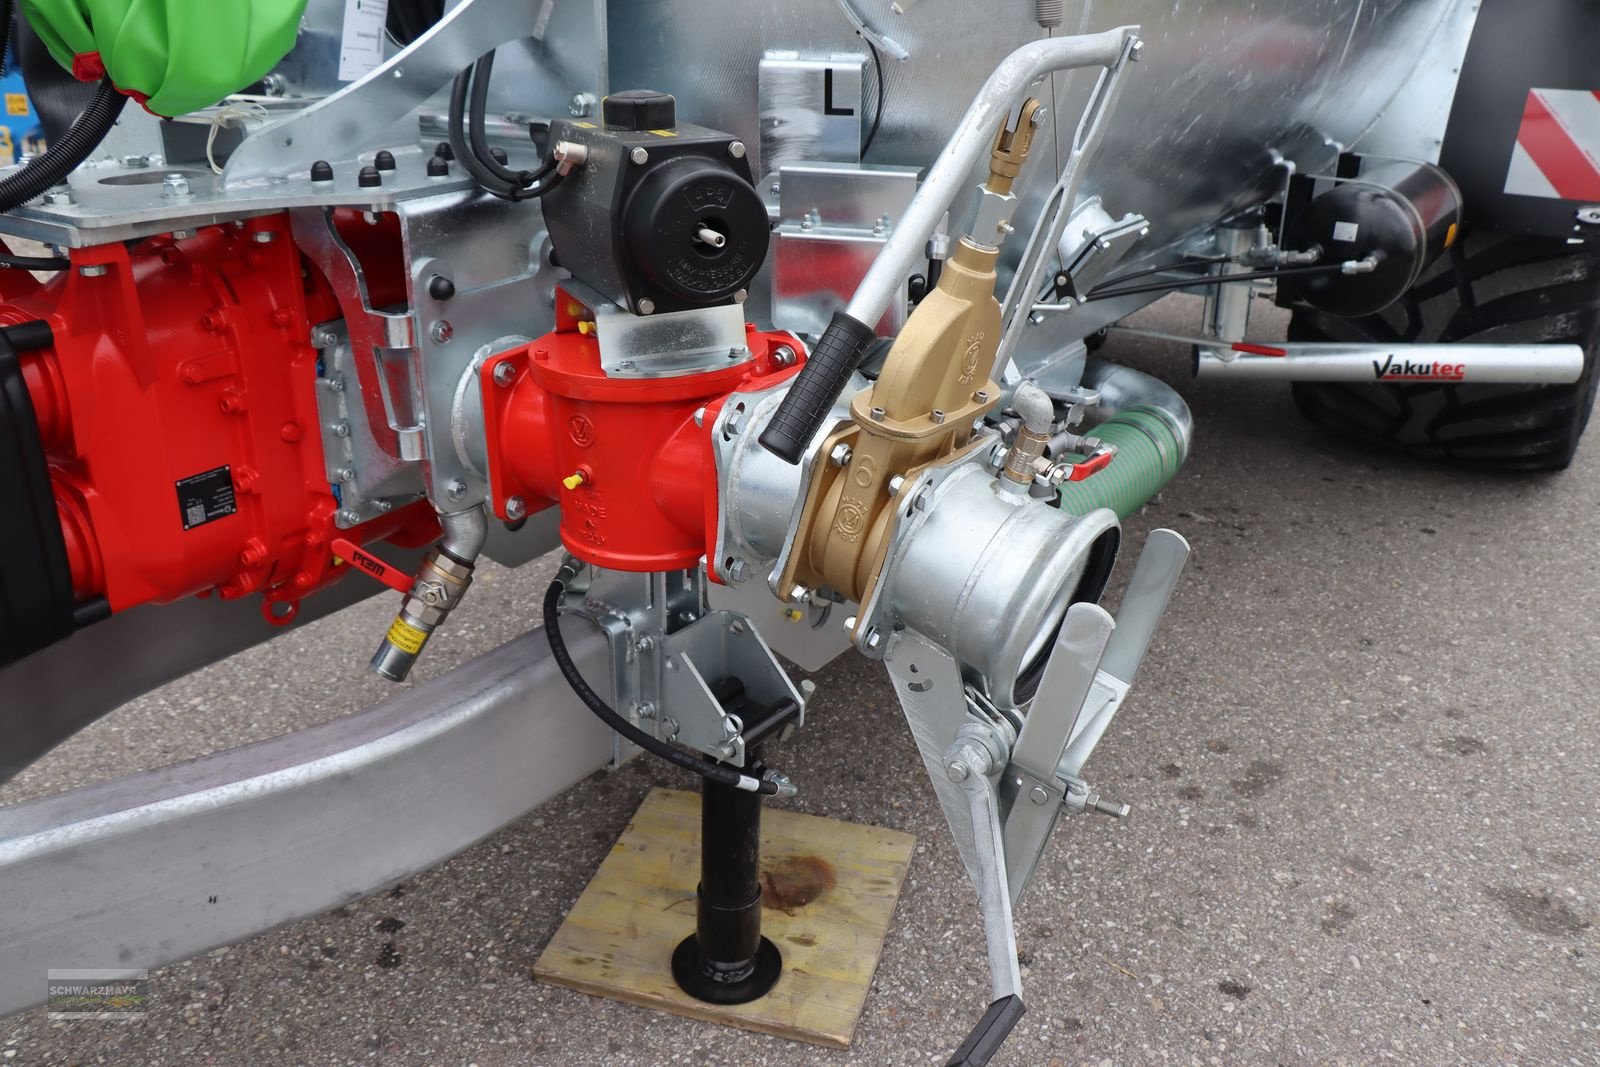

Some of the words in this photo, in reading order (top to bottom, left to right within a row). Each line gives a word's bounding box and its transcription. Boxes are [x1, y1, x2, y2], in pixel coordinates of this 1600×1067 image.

[824, 68, 854, 116] L
[1372, 354, 1465, 379] Vakutec
[856, 454, 877, 488] 6
